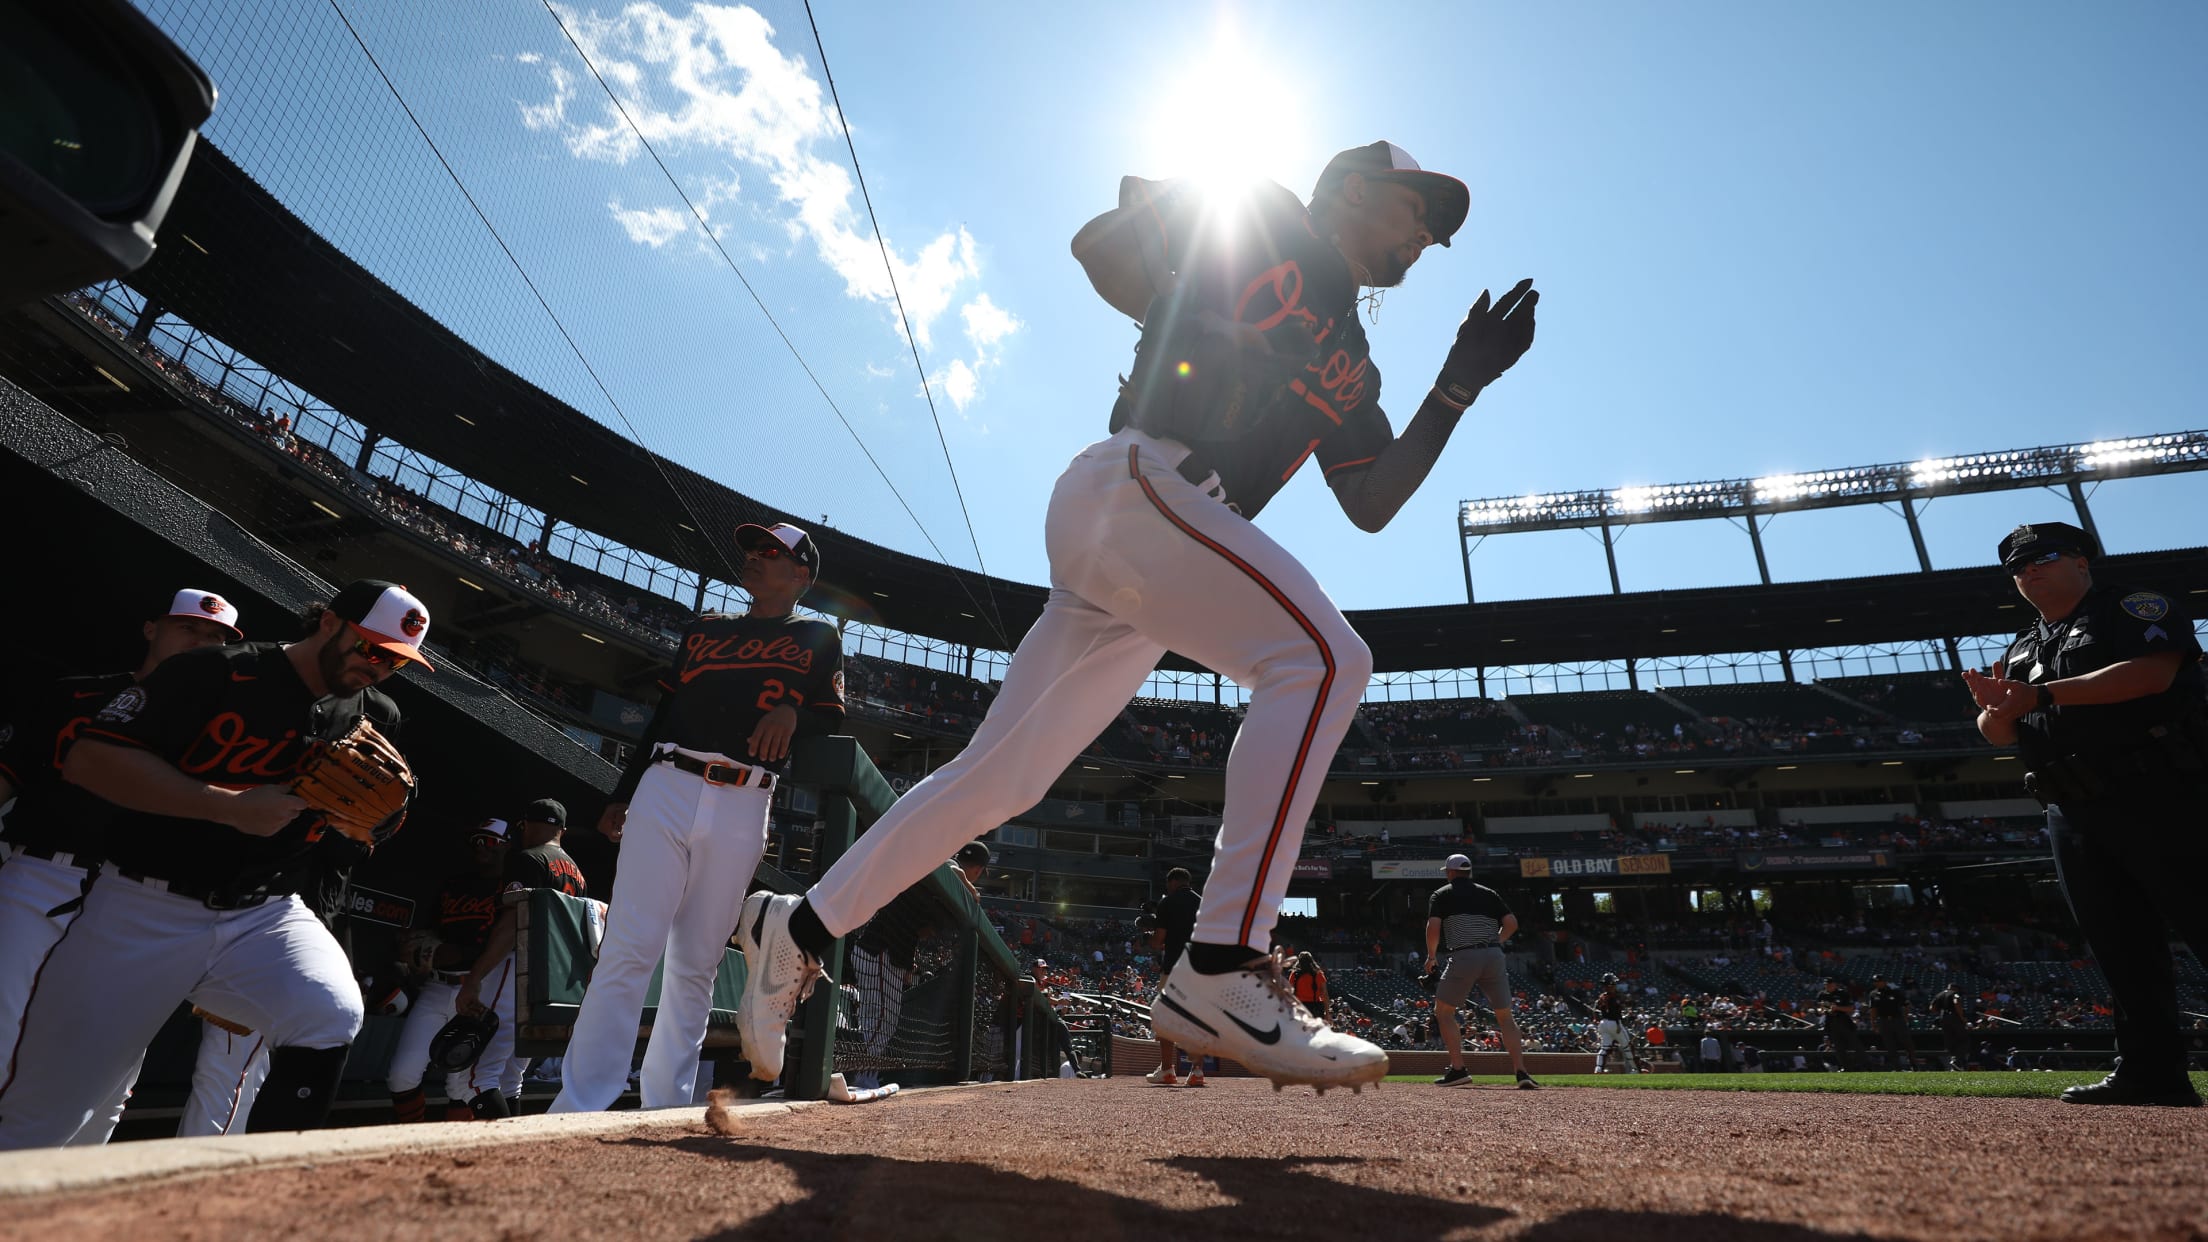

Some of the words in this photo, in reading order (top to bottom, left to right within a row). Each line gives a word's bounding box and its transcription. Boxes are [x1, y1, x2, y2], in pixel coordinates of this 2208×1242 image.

[686, 633, 813, 674] Orioles
[178, 711, 328, 777] Orio
[351, 757, 393, 785] marucci
[1553, 859, 1582, 875] OLD
[1585, 858, 1613, 873] BAY
[1623, 855, 1665, 872] SEASON
[351, 891, 409, 922] les.com
